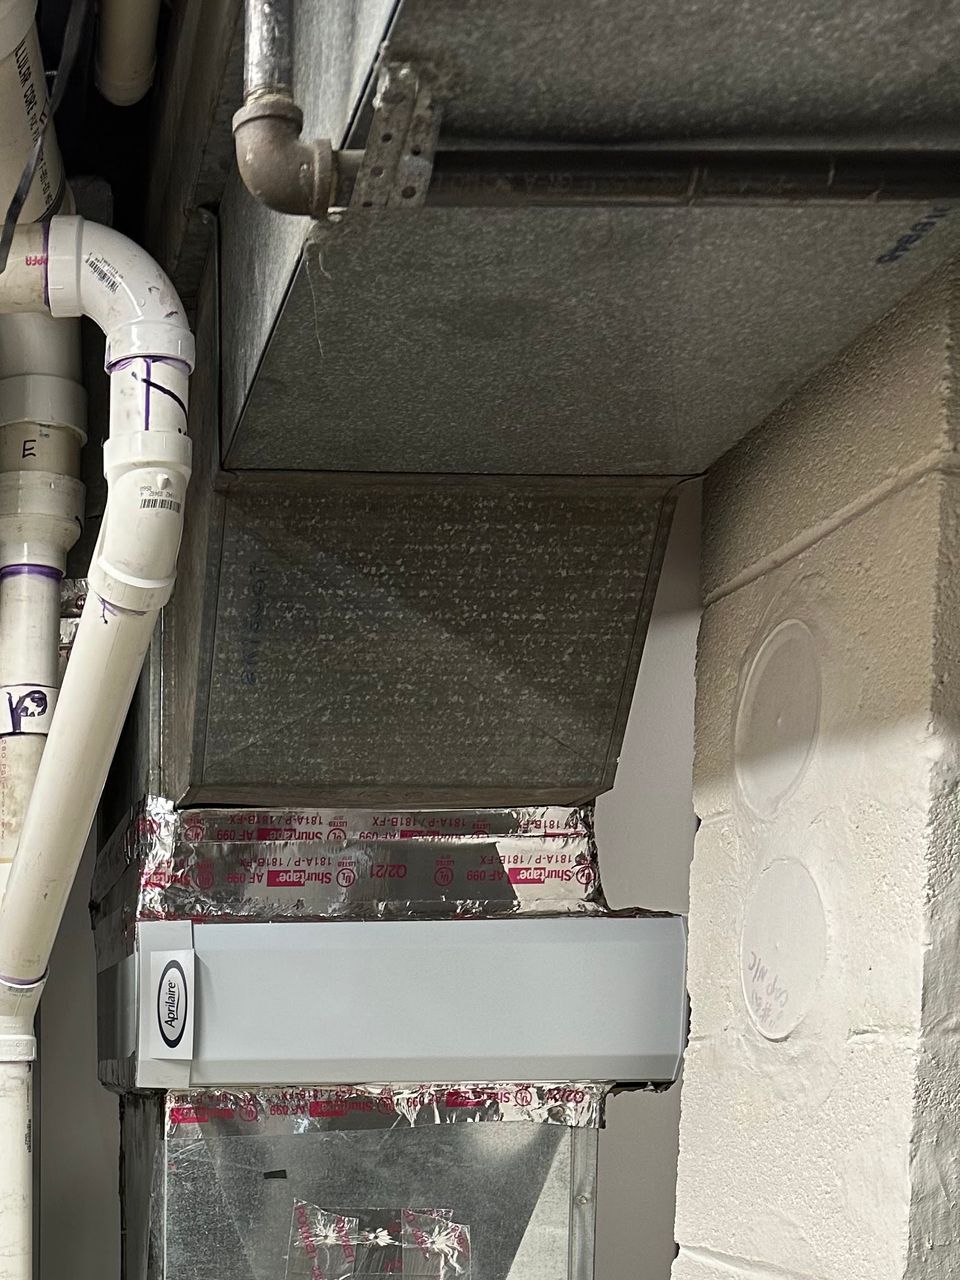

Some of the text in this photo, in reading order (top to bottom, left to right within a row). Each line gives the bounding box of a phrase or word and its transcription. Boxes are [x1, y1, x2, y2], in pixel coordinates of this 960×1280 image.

[21, 439, 37, 459] E
[227, 814, 275, 825] 181B-FX
[289, 815, 324, 825] 181A-P
[372, 816, 415, 827] 181B-FX
[428, 818, 466, 829] 181A-P
[294, 856, 332, 867] 181A-P
[479, 855, 524, 865] 181B-FX
[535, 854, 572, 864] 181A-P
[249, 872, 264, 883] AF
[275, 870, 332, 884] Shurtape
[466, 870, 487, 880] 099
[517, 869, 572, 882] Shurtape
[164, 981, 179, 1029] Aprilaire
